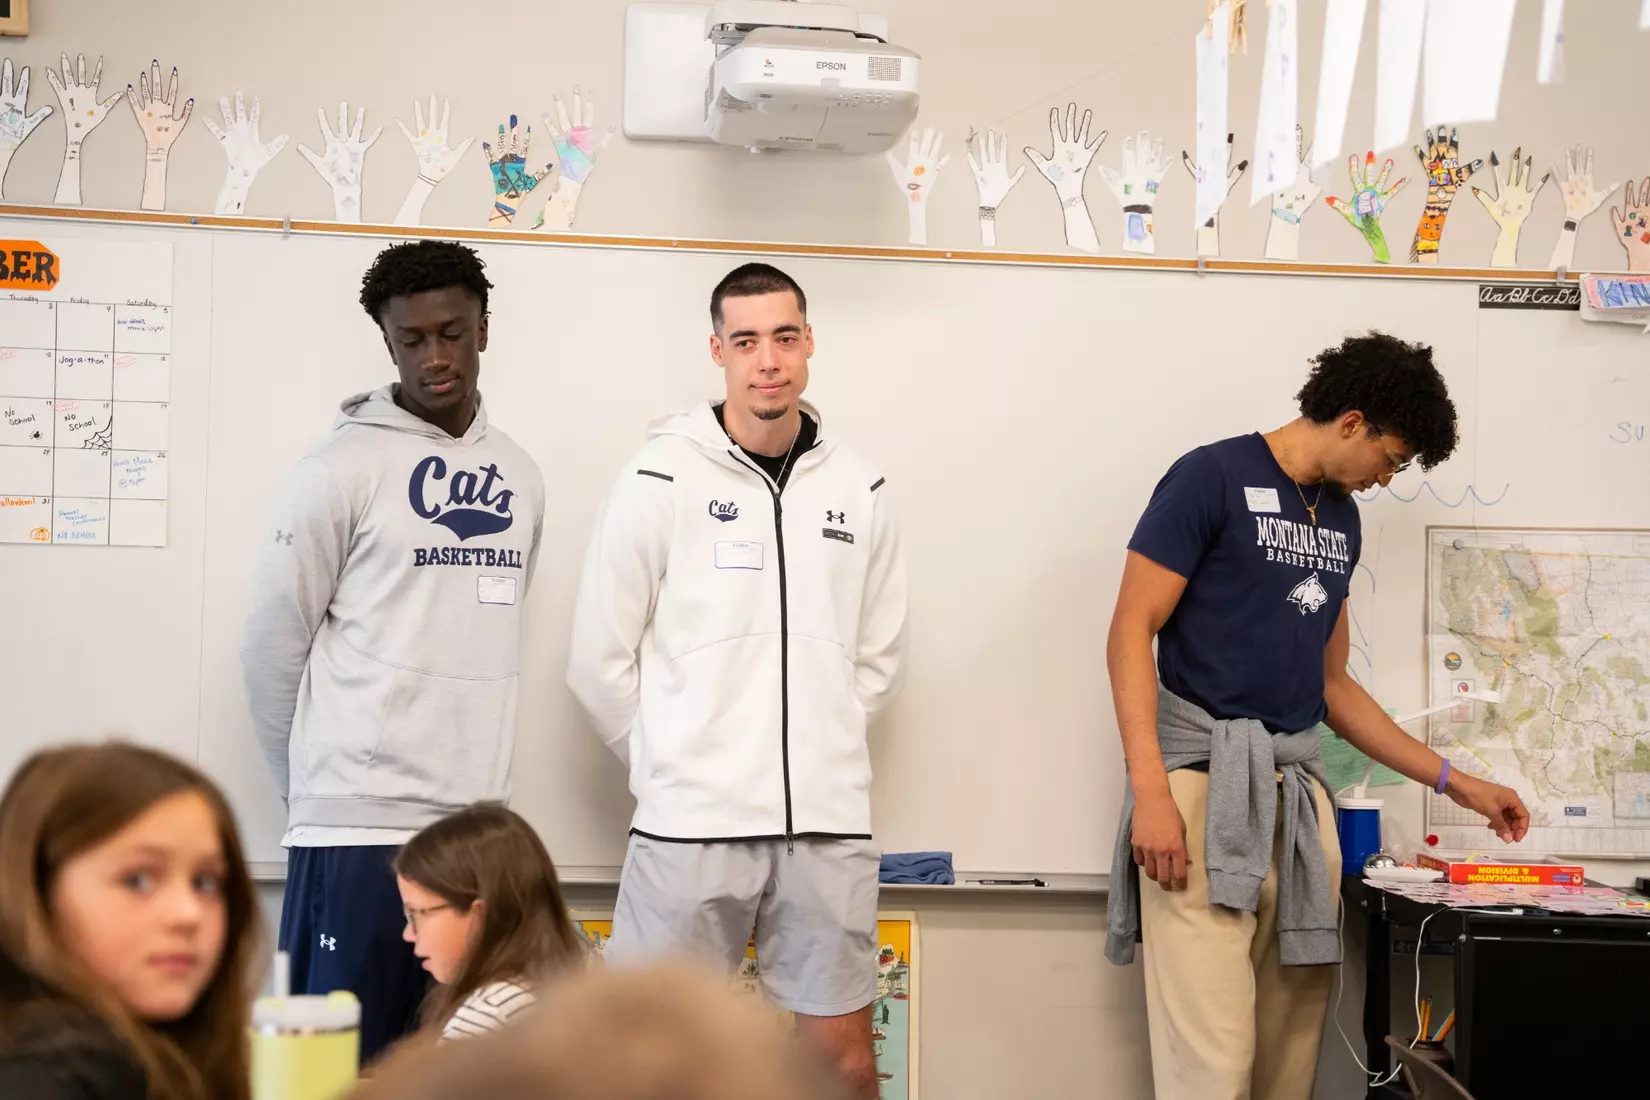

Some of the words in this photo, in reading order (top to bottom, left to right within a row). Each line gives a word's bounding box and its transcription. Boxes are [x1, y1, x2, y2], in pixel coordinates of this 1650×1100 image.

[816, 61, 846, 71] EPSON
[1508, 288, 1532, 303] Bb
[127, 299, 157, 310] Saturday
[408, 455, 515, 520] Cats
[708, 499, 740, 517] Cats
[1255, 516, 1319, 557] MONTANA
[1317, 526, 1349, 562] STATE
[413, 546, 522, 569] BASKETBALL
[1266, 548, 1346, 574] BASKETBALL
[1467, 874, 1540, 883] MULTIPLICATION
[1478, 867, 1519, 875] DIVISION
